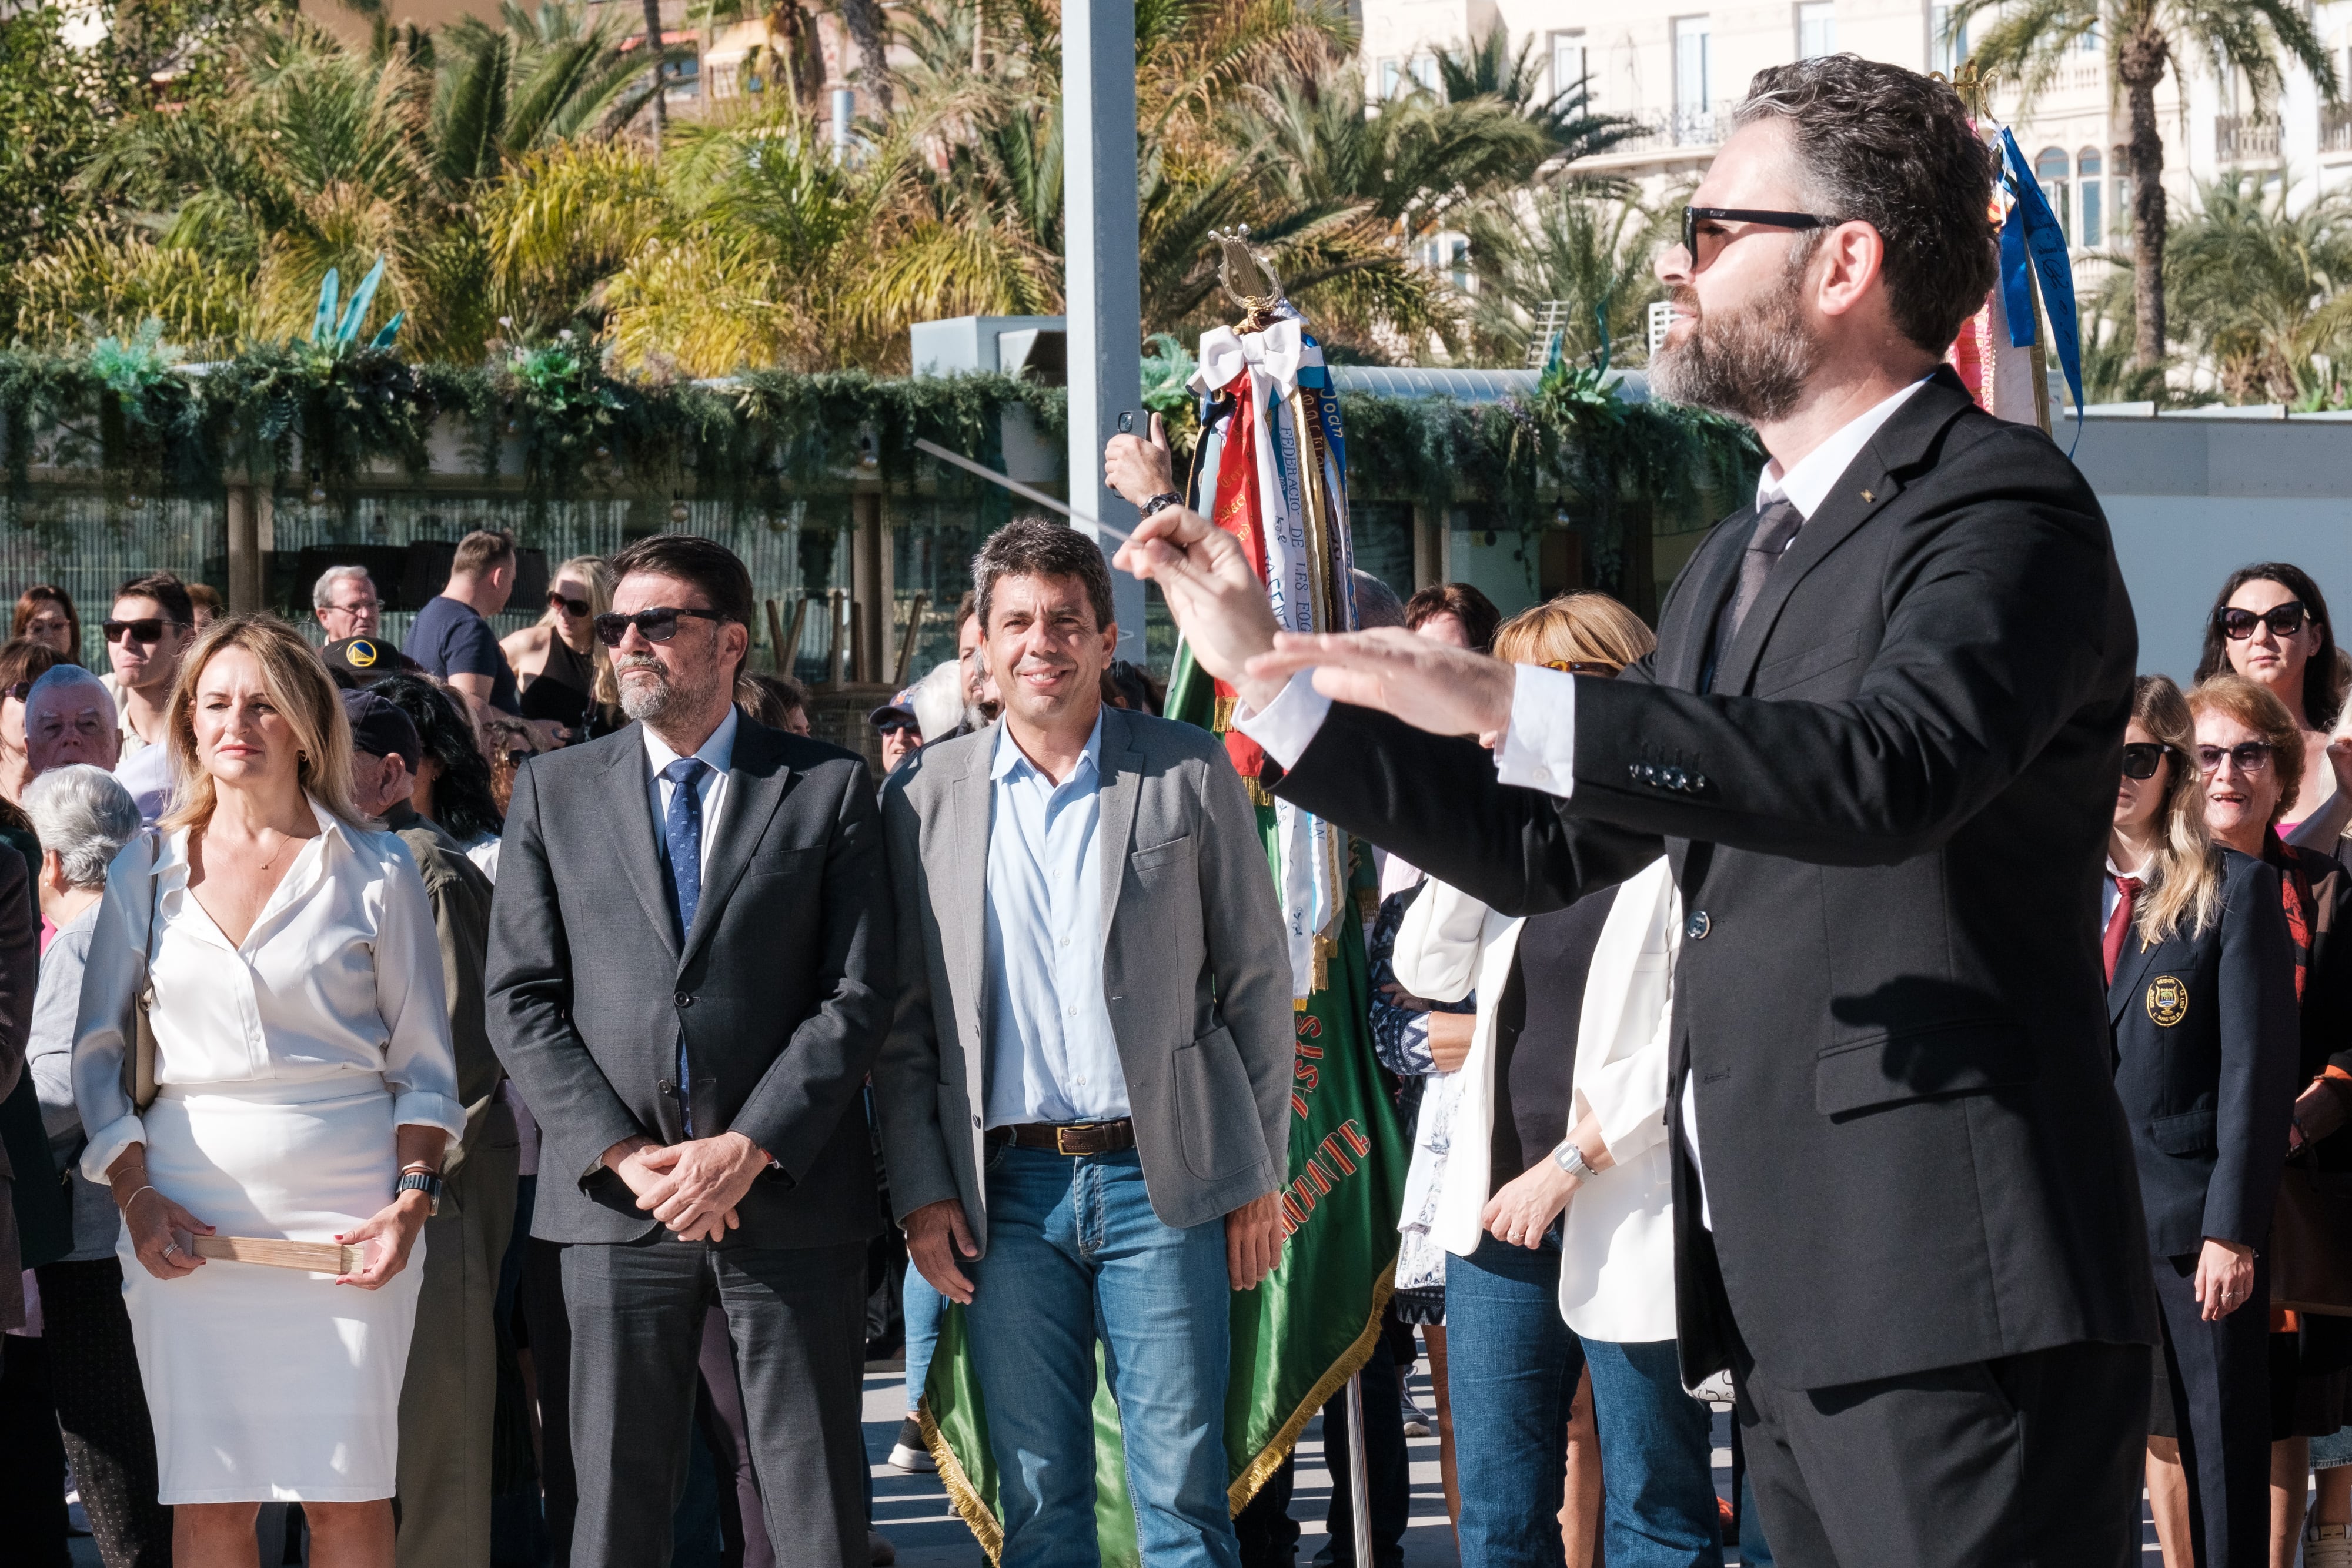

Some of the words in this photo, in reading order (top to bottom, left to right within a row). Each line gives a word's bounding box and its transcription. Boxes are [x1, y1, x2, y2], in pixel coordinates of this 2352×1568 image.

[1319, 388, 1343, 438] Joan
[1291, 528, 1304, 548] DE
[1282, 1119, 1371, 1242] ICANTE
